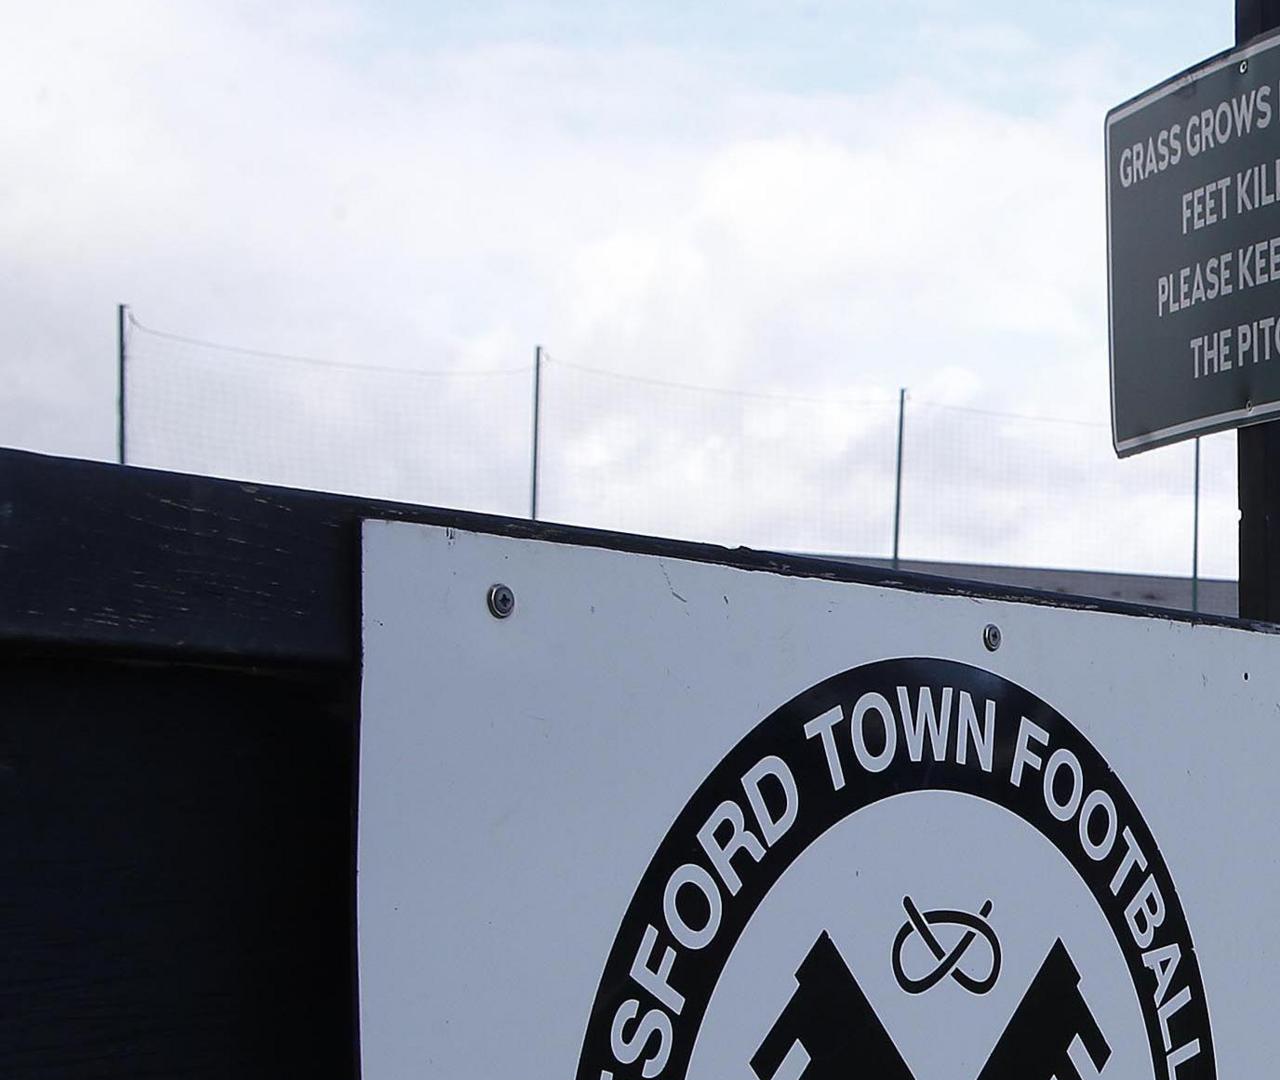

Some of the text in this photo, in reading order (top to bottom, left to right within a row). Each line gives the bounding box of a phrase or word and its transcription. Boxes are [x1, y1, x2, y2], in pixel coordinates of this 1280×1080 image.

[1119, 124, 1182, 188] GRASS
[1186, 85, 1272, 158] GROWS
[1182, 177, 1231, 234] FEET
[1158, 249, 1233, 317] PLEASE
[1190, 327, 1232, 378] THE
[803, 686, 996, 791] TOWN
